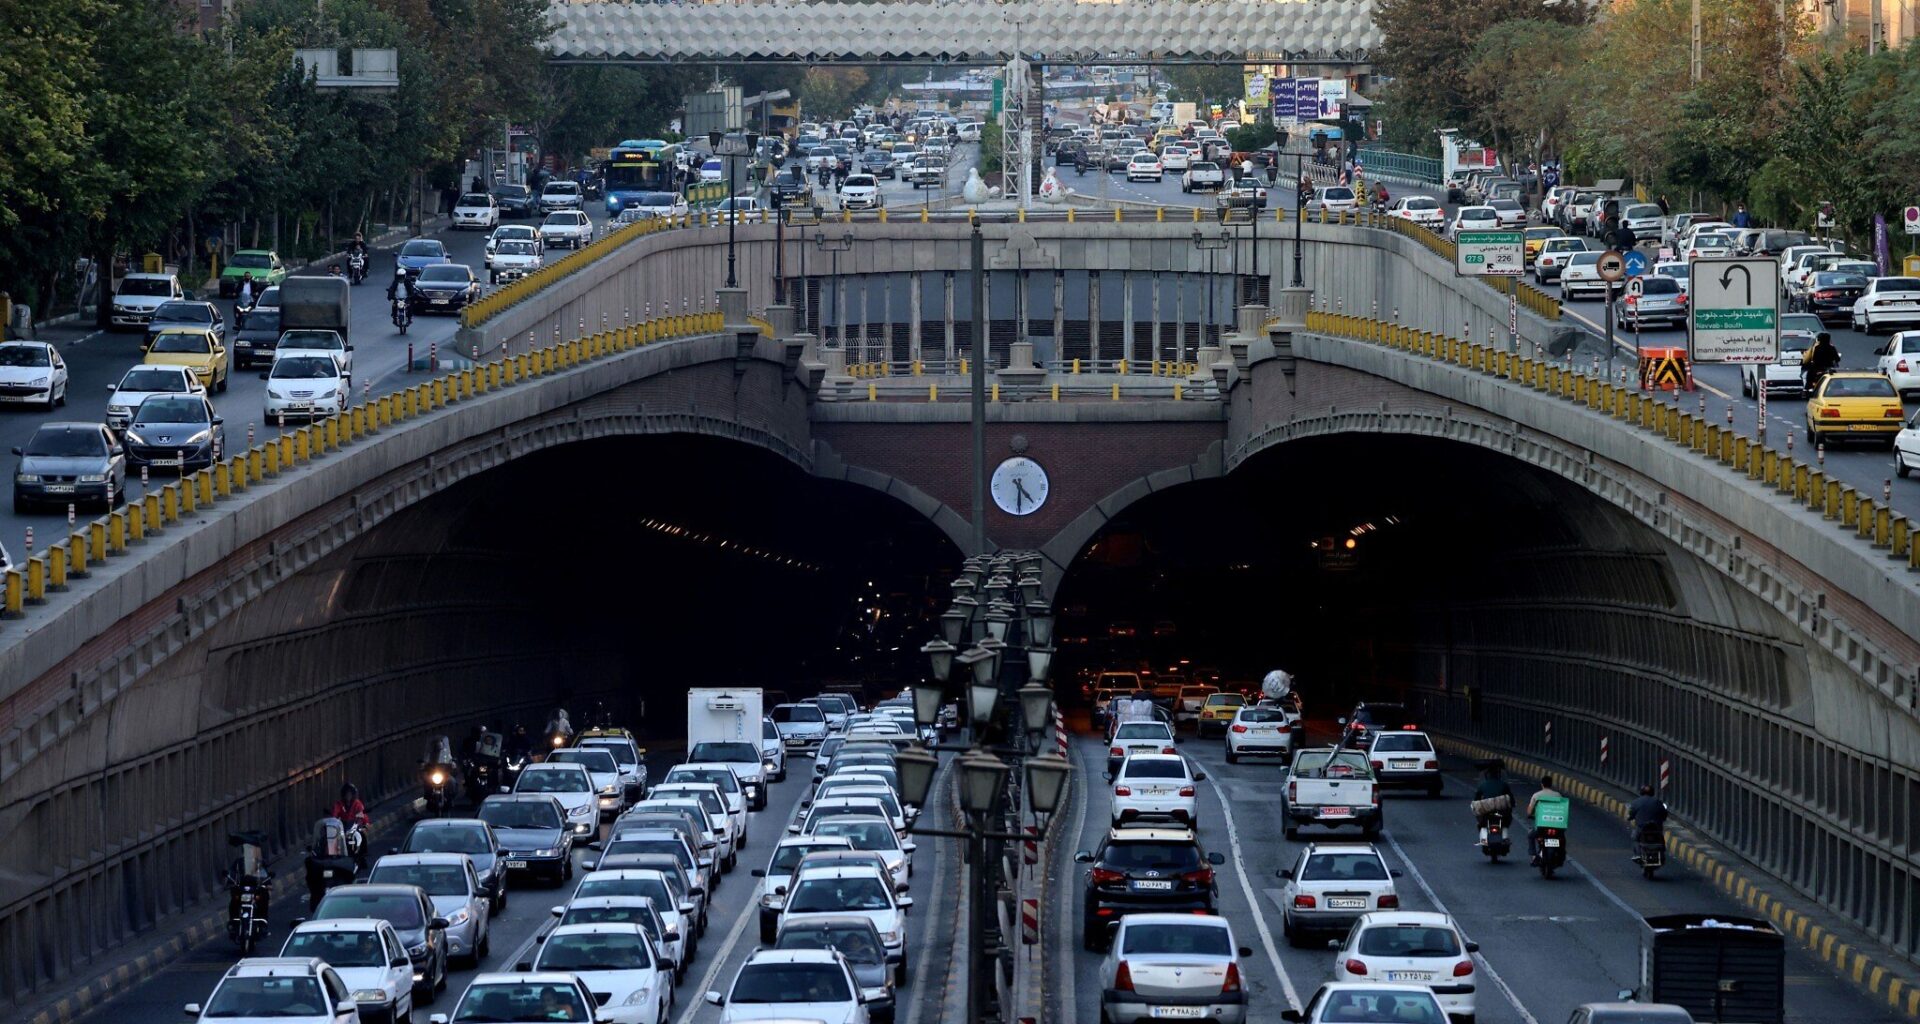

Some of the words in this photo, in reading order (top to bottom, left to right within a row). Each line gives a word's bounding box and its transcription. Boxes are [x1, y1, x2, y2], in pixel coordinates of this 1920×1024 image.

[1480, 245, 1498, 253] خمینی
[1499, 245, 1512, 253] امام
[1696, 311, 1718, 320] جنوب
[1723, 310, 1743, 320] نواب
[1743, 310, 1764, 319] شهید
[1722, 335, 1746, 344] خمینی
[1747, 335, 1764, 344] امام
[1745, 346, 1766, 354] Airport
